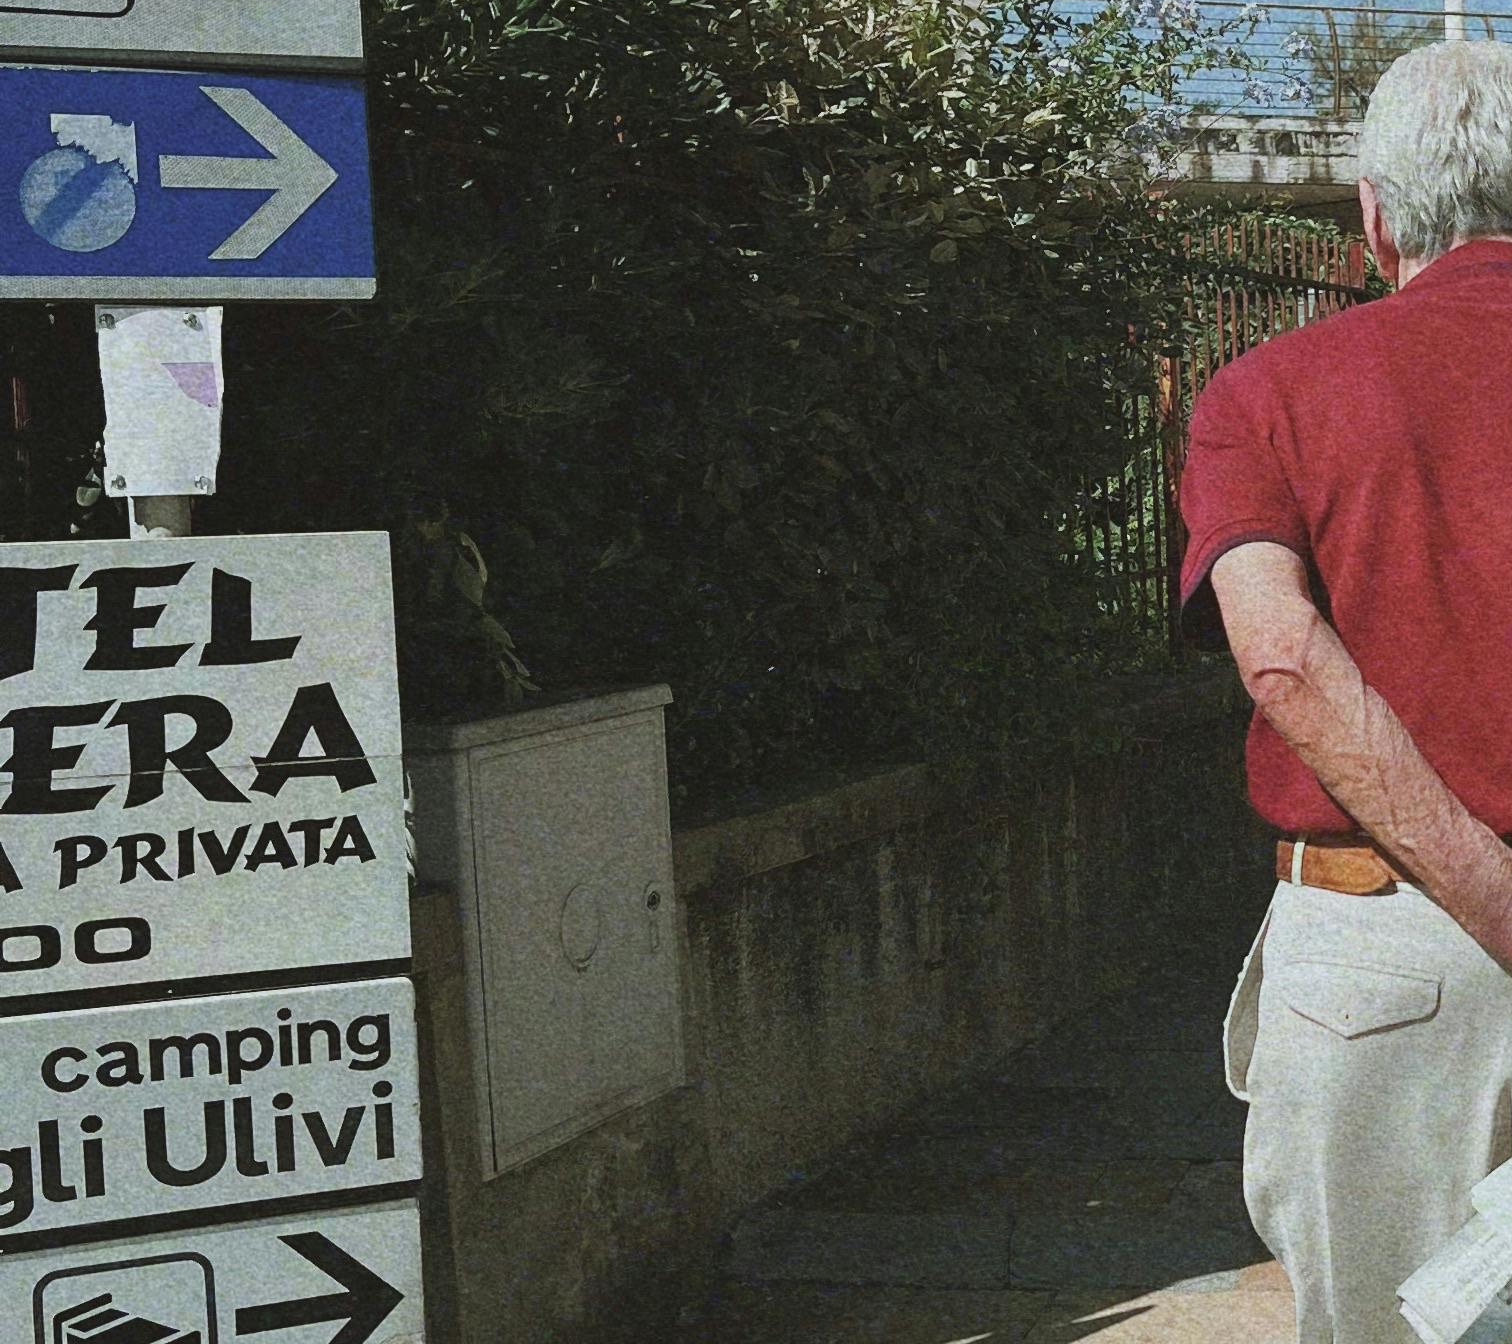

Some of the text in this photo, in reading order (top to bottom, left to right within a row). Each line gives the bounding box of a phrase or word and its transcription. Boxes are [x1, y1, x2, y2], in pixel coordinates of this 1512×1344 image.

[0, 561, 303, 682] TEL
[0, 681, 379, 816] ERA
[52, 814, 378, 891] PRIVATA
[40, 1006, 391, 1094] camping
[142, 1079, 396, 1188] Ulivi
